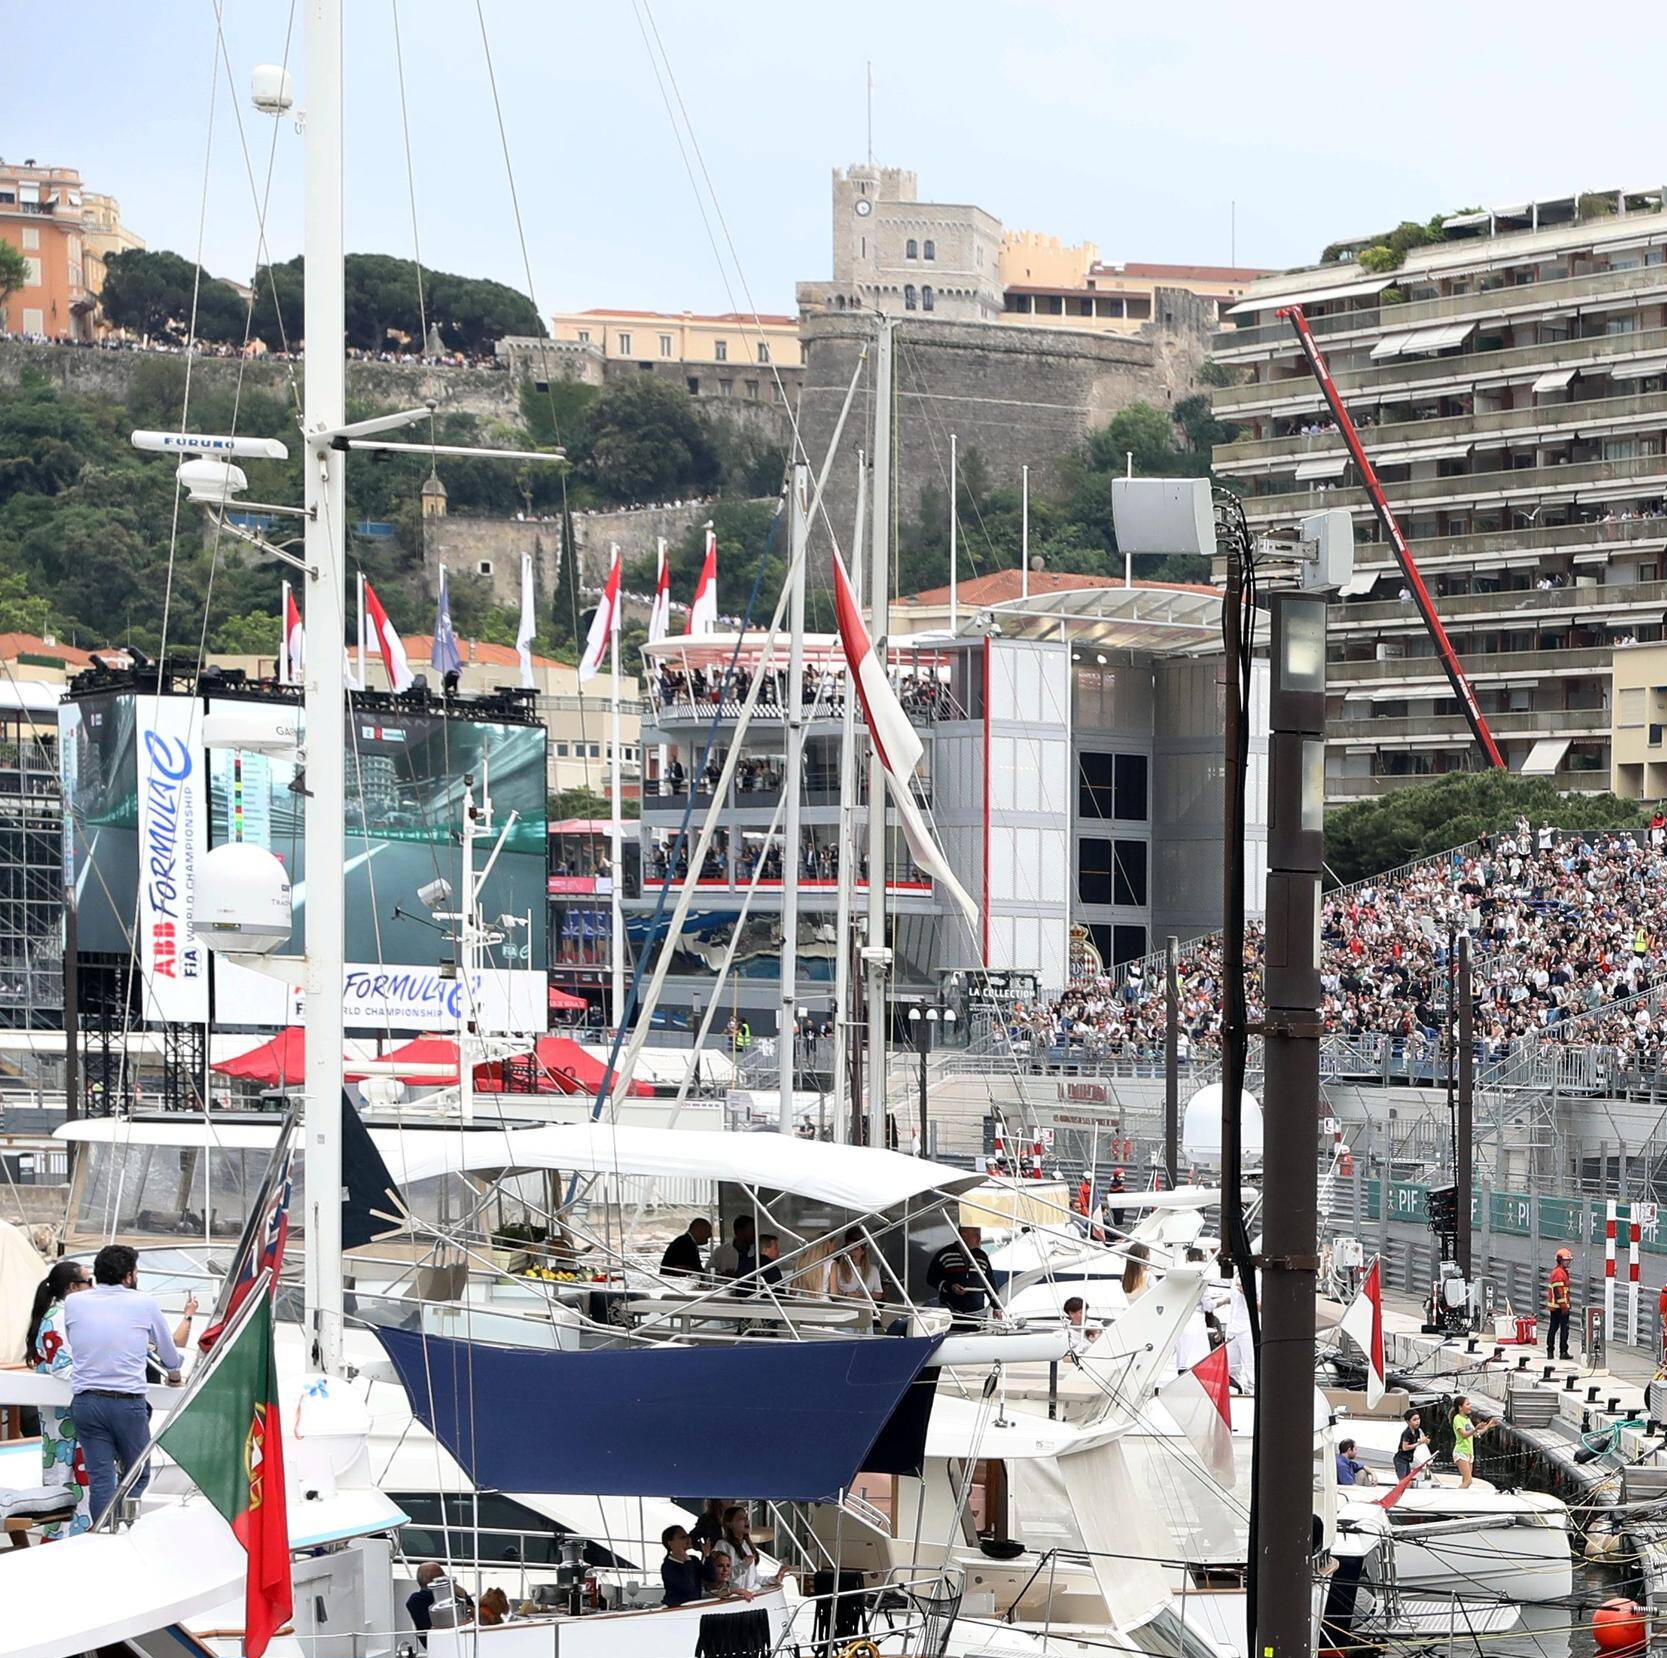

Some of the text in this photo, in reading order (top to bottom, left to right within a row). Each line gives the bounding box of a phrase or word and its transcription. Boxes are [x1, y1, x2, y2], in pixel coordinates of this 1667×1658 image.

[148, 777, 179, 918] FORMULA
[153, 922, 176, 979] ABB
[343, 971, 445, 1003] FORMULA
[969, 987, 1036, 998] LA COLLECTION
[1398, 1188, 1419, 1212] PIF
